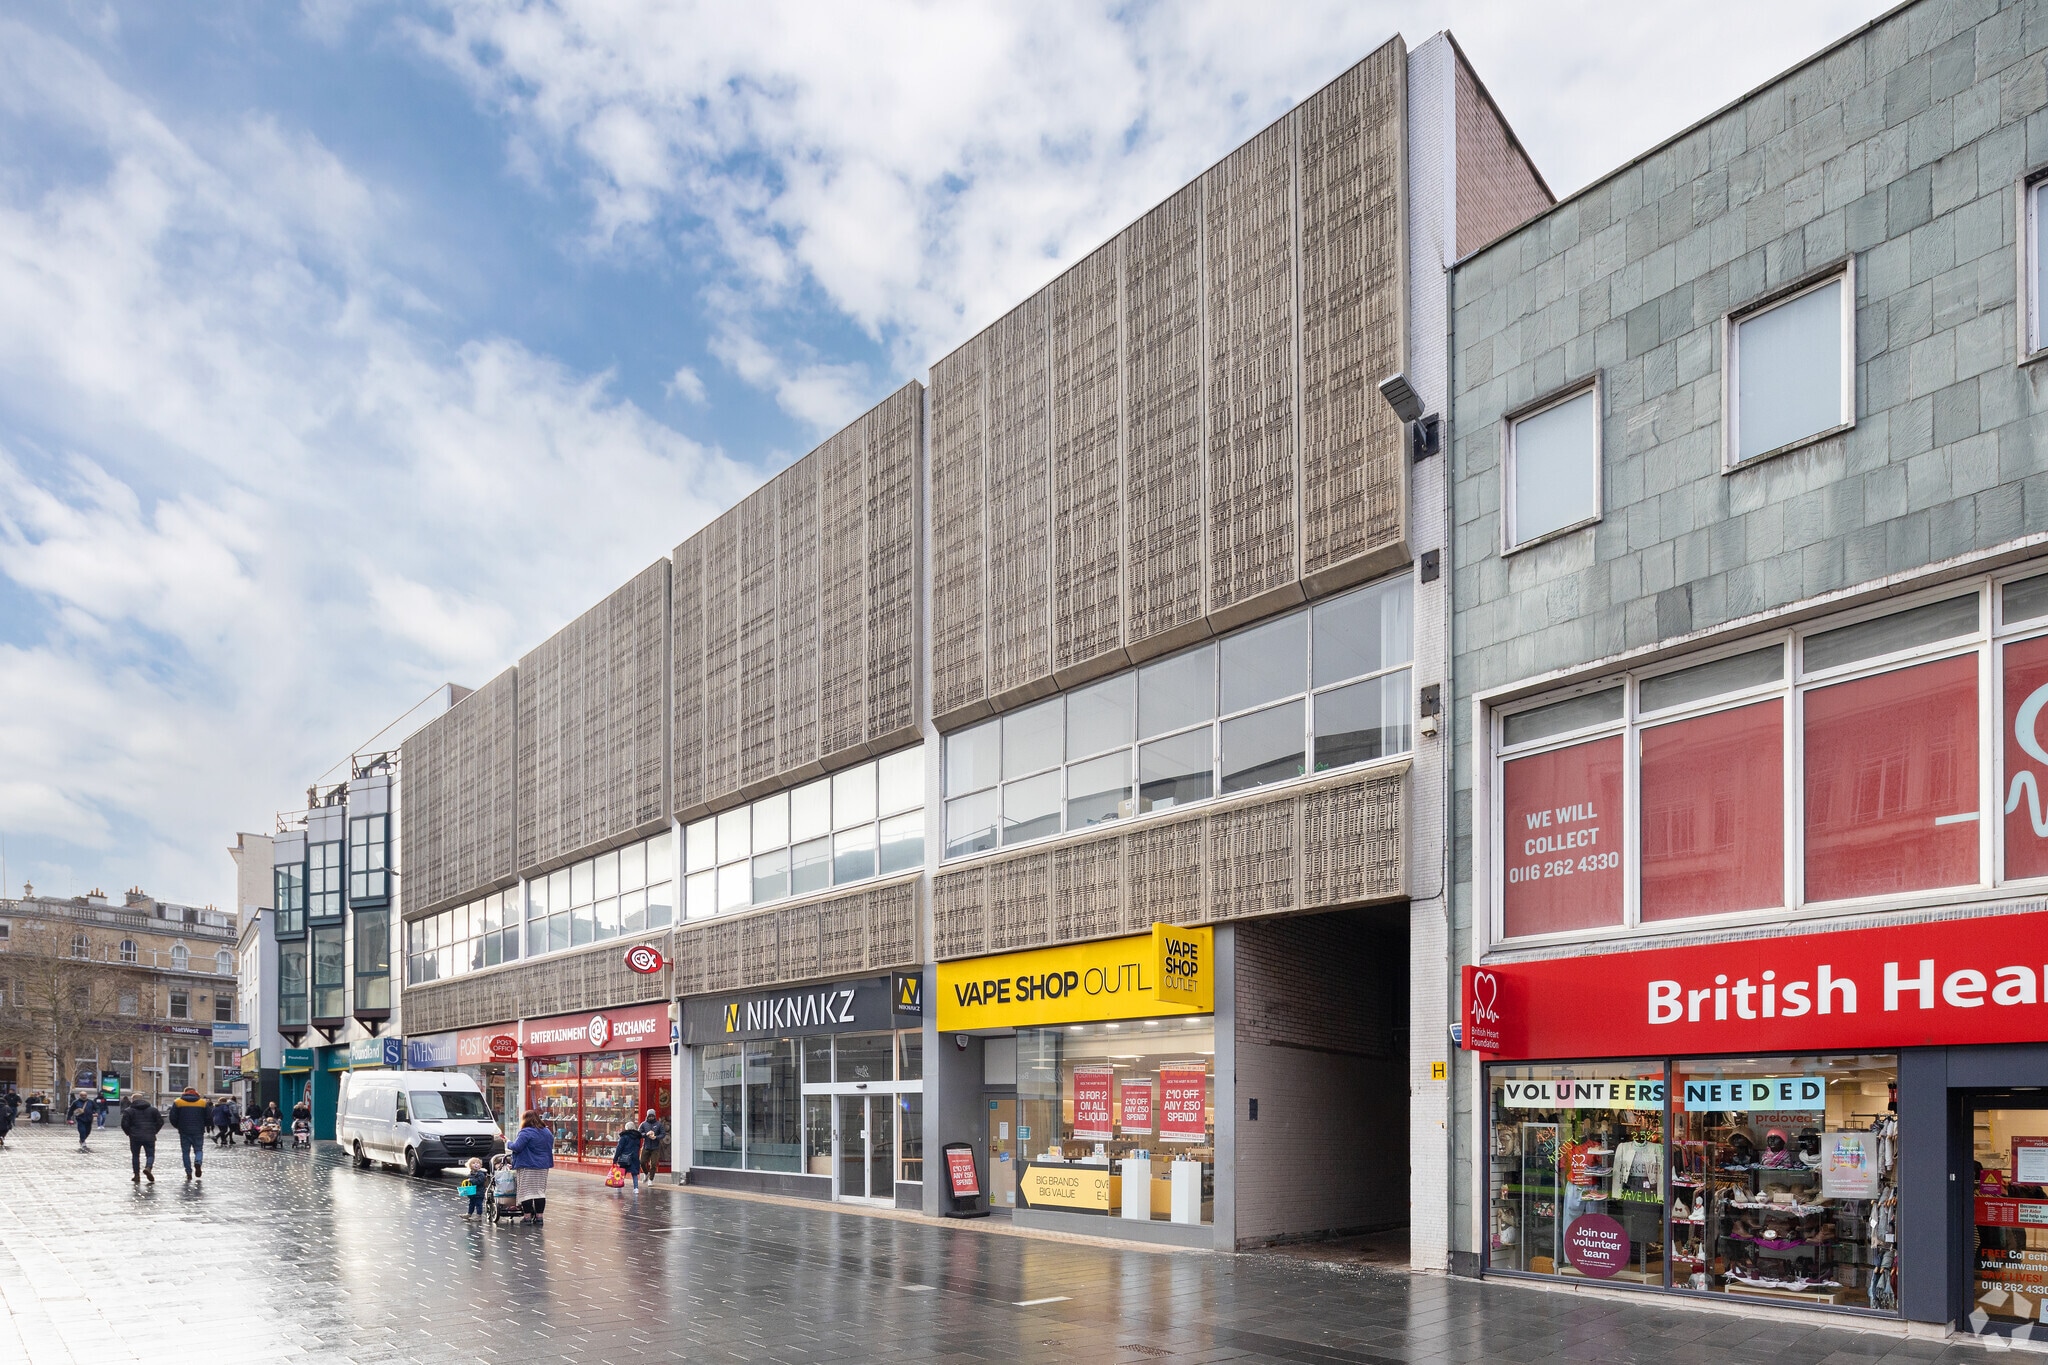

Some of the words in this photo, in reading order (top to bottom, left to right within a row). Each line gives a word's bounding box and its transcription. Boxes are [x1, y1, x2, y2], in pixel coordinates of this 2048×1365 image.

[1526, 810, 1552, 830] WE
[1556, 802, 1598, 825] WILL
[1525, 827, 1600, 856] COLLECT
[1509, 864, 1540, 884] 0116
[1544, 859, 1574, 878] 262
[1577, 851, 1619, 872] 4330
[1165, 937, 1198, 960] VAPE
[1165, 957, 1198, 978] SHOP
[954, 978, 1011, 1007] VAPE
[1016, 971, 1079, 1002] SHOP
[1084, 963, 1153, 995] OUTL
[1164, 976, 1198, 993] OUTLET
[1648, 964, 1857, 1025] British
[1884, 958, 2048, 1012] Hea
[747, 989, 855, 1031] NIKNAKZ
[172, 1026, 199, 1034] NatWest
[530, 1026, 587, 1044] ENTERTAINMENT
[613, 1018, 656, 1036] EXCHANGE
[1471, 1026, 1486, 1037] British
[1486, 1028, 1499, 1039] Heart
[460, 1036, 482, 1056] POST
[1471, 1036, 1499, 1049] Foundation
[351, 1045, 380, 1061] Poundland
[386, 1045, 399, 1064] S
[413, 1040, 451, 1062] WHSmith
[1433, 1063, 1444, 1078] H
[1079, 1091, 1085, 1099] 3
[1086, 1091, 1101, 1099] FOR
[1101, 1091, 1107, 1099] 2
[1166, 1090, 1181, 1099] £10
[1183, 1089, 1199, 1099] OFF
[1506, 1083, 1664, 1102] VOLUNTEERS
[1687, 1082, 1820, 1102] NEEDED
[1080, 1102, 1091, 1110] ON
[1092, 1102, 1106, 1110] ALL
[1164, 1101, 1181, 1110] ANY
[1183, 1101, 1201, 1110] £50
[1078, 1112, 1108, 1123] E-LIQUID
[1126, 1113, 1147, 1121] SPEND!
[1167, 1112, 1197, 1122] SPEND!
[1755, 1112, 1812, 1127] preloved
[1036, 1176, 1048, 1185] BIG
[1049, 1177, 1079, 1187] BRANDS
[1039, 1187, 1051, 1197] BIG
[1051, 1188, 1076, 1198] VALUE
[1576, 1226, 1598, 1238] Join
[1600, 1231, 1618, 1240] our
[1572, 1238, 1621, 1251] volunteer
[1582, 1248, 1610, 1260] team
[1981, 1248, 2007, 1258] FREE
[1981, 1260, 2004, 1269] your
[1981, 1270, 2007, 1281] SAVE
[2009, 1272, 2043, 1283] LIVES!
[1981, 1280, 2002, 1291] 0116
[2004, 1282, 2024, 1293] 262
